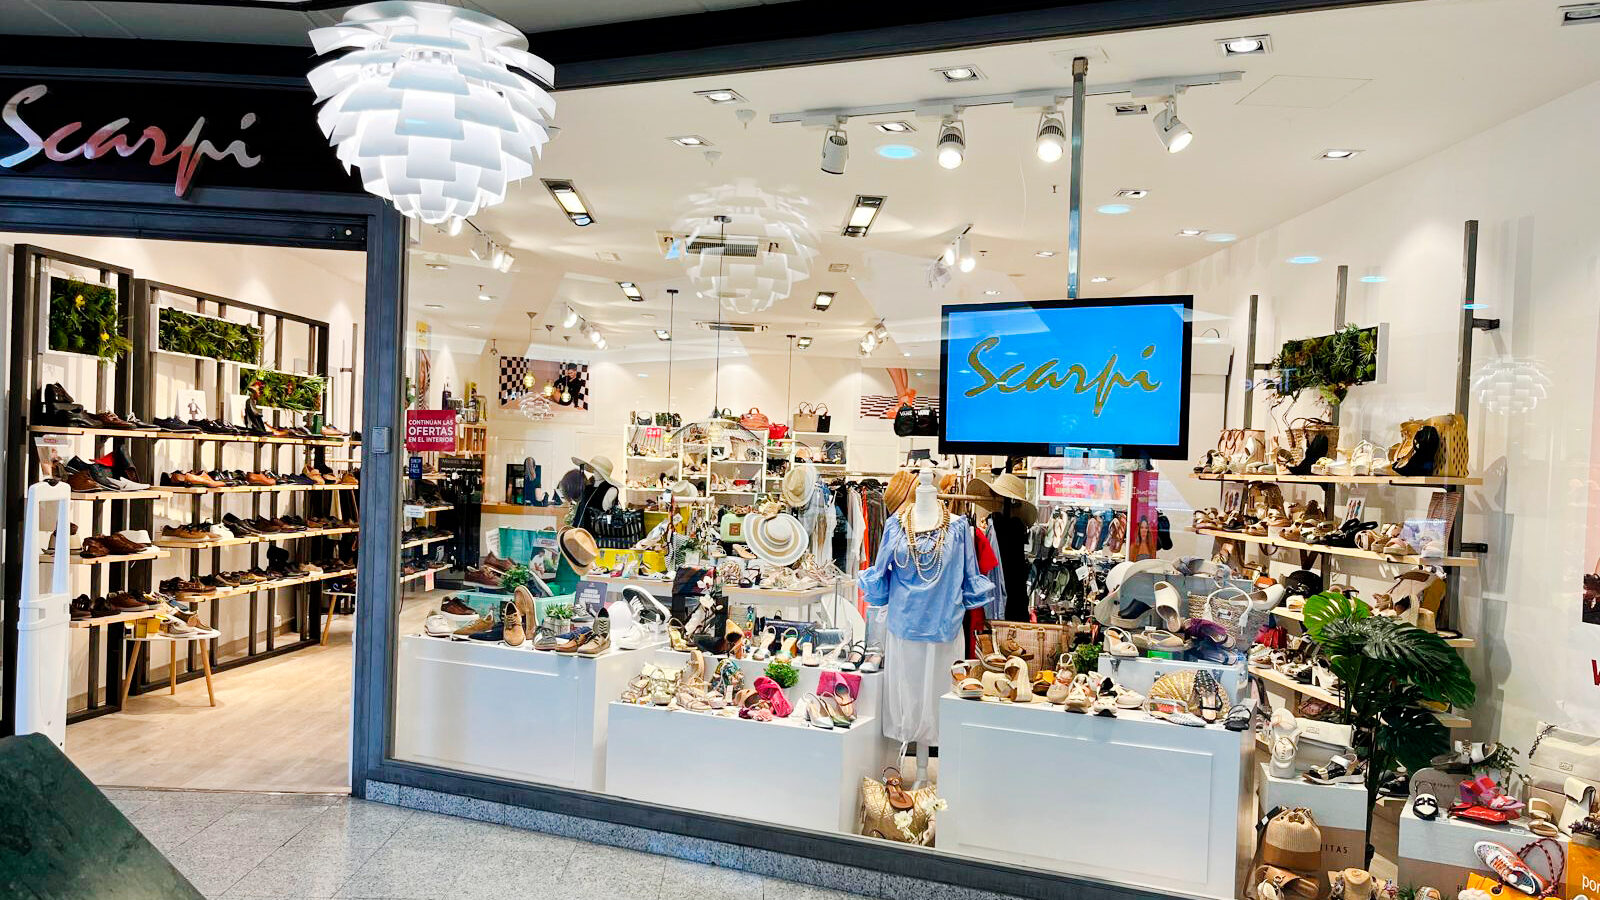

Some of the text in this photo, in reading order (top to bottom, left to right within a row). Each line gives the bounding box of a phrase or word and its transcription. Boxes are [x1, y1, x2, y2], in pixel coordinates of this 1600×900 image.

[0, 84, 262, 197] Scarpi
[964, 336, 1163, 418] Scarpi
[408, 427, 453, 435] OFERTAS
